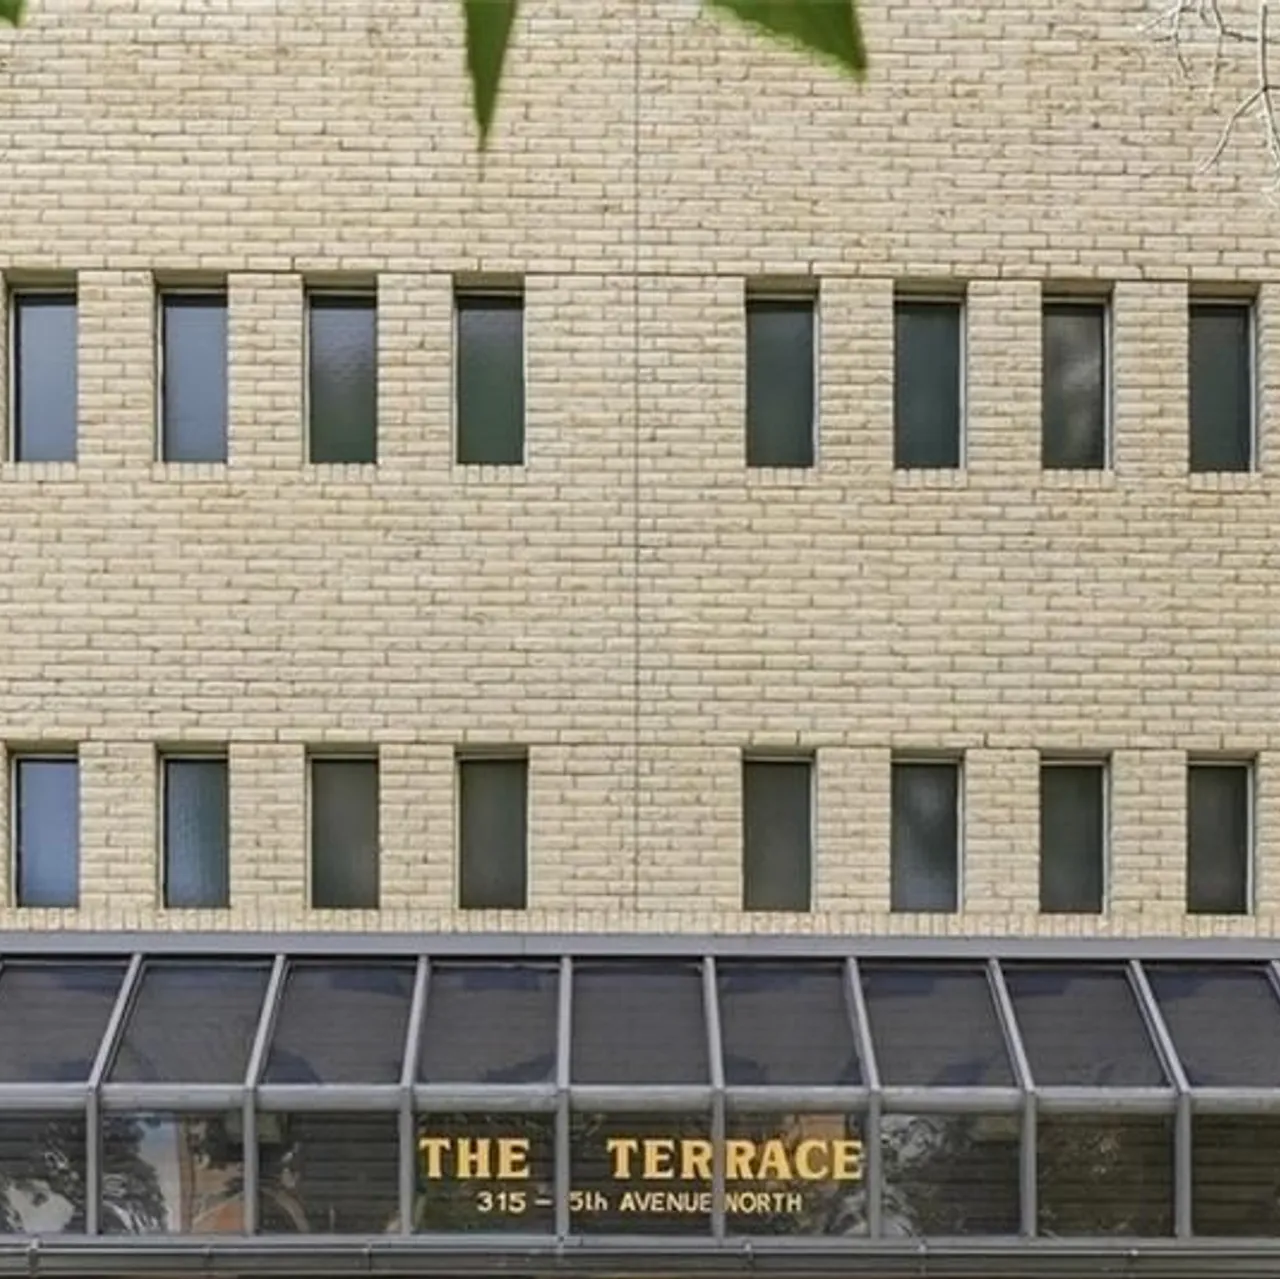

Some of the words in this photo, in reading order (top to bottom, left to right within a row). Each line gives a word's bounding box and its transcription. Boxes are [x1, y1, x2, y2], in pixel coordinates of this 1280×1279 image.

[419, 1137, 531, 1179] THE
[606, 1138, 864, 1180] TERRACE
[477, 1191, 527, 1213] 315
[568, 1191, 608, 1212] 5th
[619, 1192, 713, 1213] AVENUE
[723, 1192, 803, 1213] NORTH
